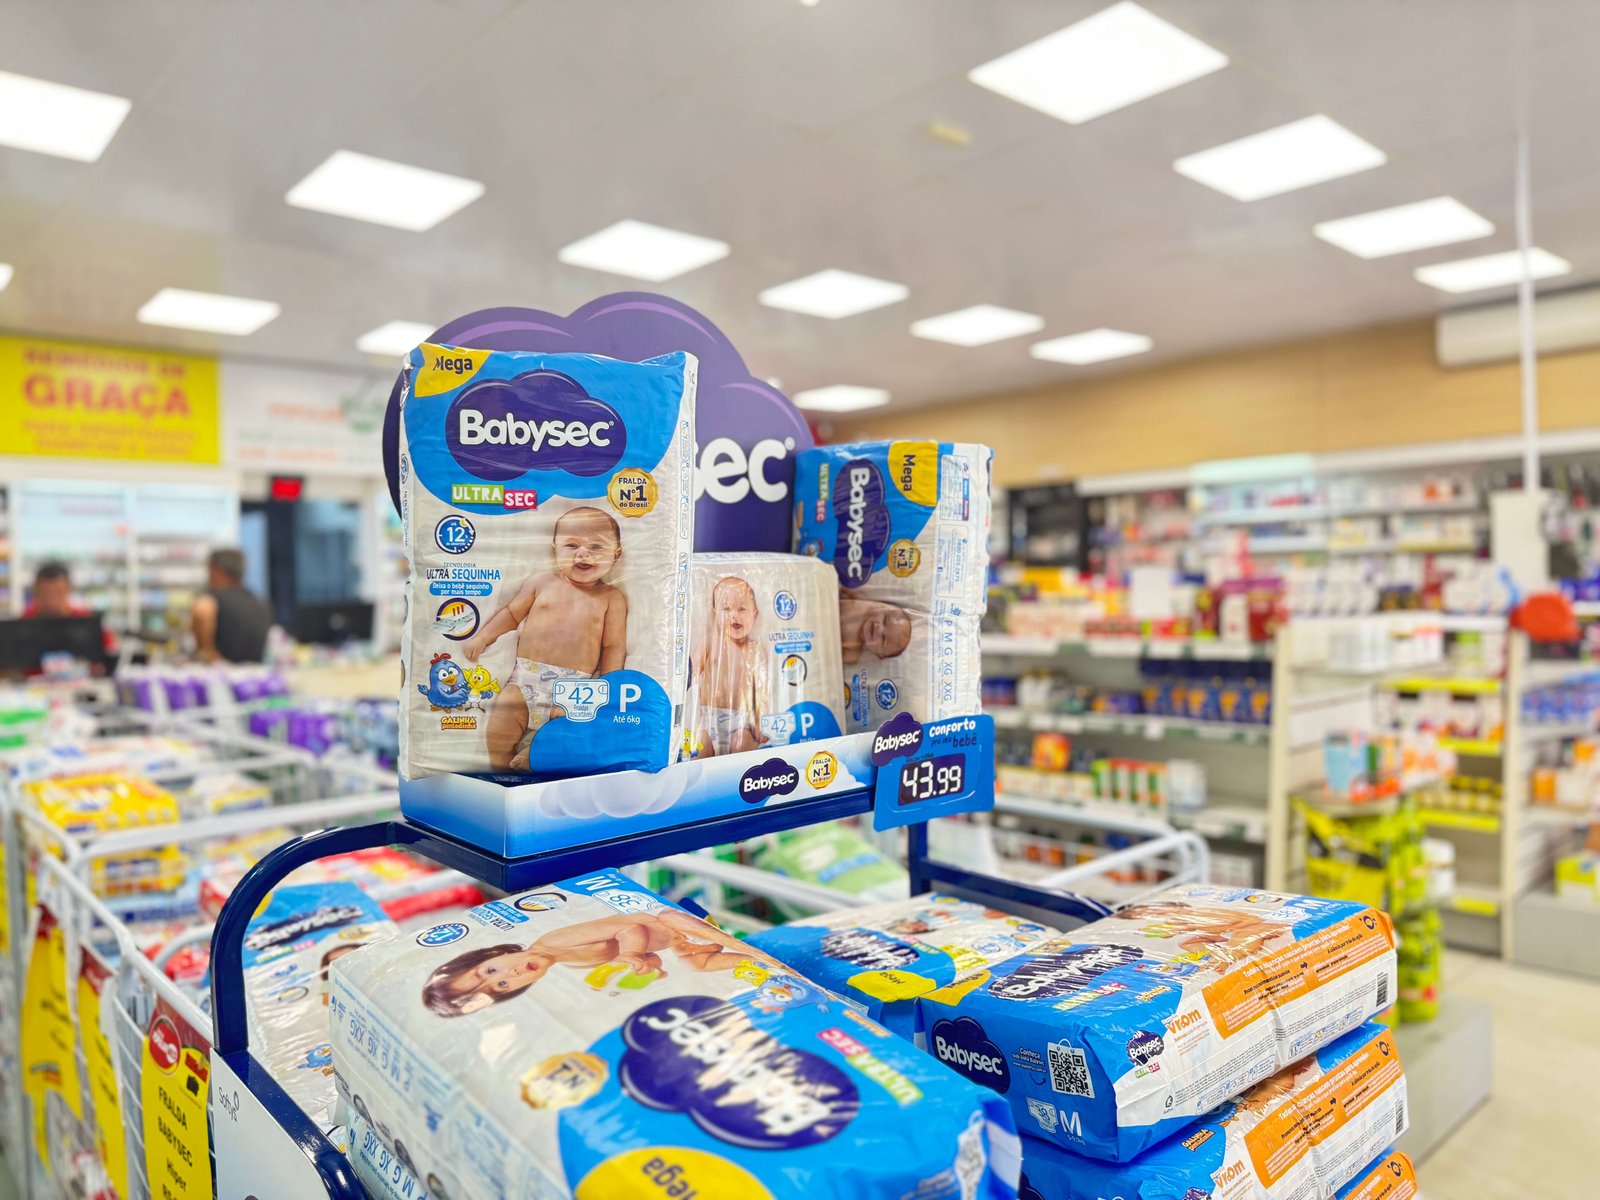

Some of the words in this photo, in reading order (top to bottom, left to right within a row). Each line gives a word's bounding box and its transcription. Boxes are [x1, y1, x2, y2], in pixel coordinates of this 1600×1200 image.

[24, 373, 190, 419] GRAÇA
[459, 409, 611, 452] Babysec
[618, 477, 647, 485] FRALDA
[819, 463, 829, 500] ULTRA
[901, 454, 916, 492] Mega
[452, 486, 502, 502] ULTRA
[504, 493, 535, 507] SEC
[816, 499, 825, 522] SEC
[847, 467, 871, 578] Babysec
[427, 569, 449, 579] ULTRA
[452, 569, 501, 580] SEQUINHA
[943, 632, 952, 642] M
[943, 647, 952, 656] G
[943, 662, 952, 675] XG
[568, 687, 594, 704] 42
[619, 684, 642, 712] P
[943, 681, 952, 701] XXG
[613, 715, 626, 723] Até
[627, 715, 641, 725] 6kg
[771, 719, 787, 733] 42
[800, 713, 815, 736] P
[873, 730, 920, 753] Babysec
[953, 732, 977, 748] bebê
[743, 773, 795, 792] Babysec
[902, 761, 962, 799] 43.99
[575, 876, 617, 892] M
[609, 893, 640, 909] 38
[1293, 899, 1329, 910] M
[349, 1020, 365, 1042] XXG
[367, 1036, 379, 1057] XG
[821, 1029, 865, 1055] SEC
[1129, 1037, 1160, 1059] Babysec
[381, 1051, 389, 1070] G
[935, 1036, 1002, 1076] Babysec
[1020, 1047, 1041, 1059] Conheça
[391, 1064, 401, 1082] M
[158, 1085, 187, 1130] FRALDA
[1060, 1110, 1082, 1136] M
[158, 1115, 193, 1168] BABYSEC
[363, 1130, 381, 1155] XXG
[378, 1150, 393, 1171] XG
[392, 1164, 402, 1184] G
[641, 1157, 699, 1200] ega
[402, 1178, 416, 1198] M
